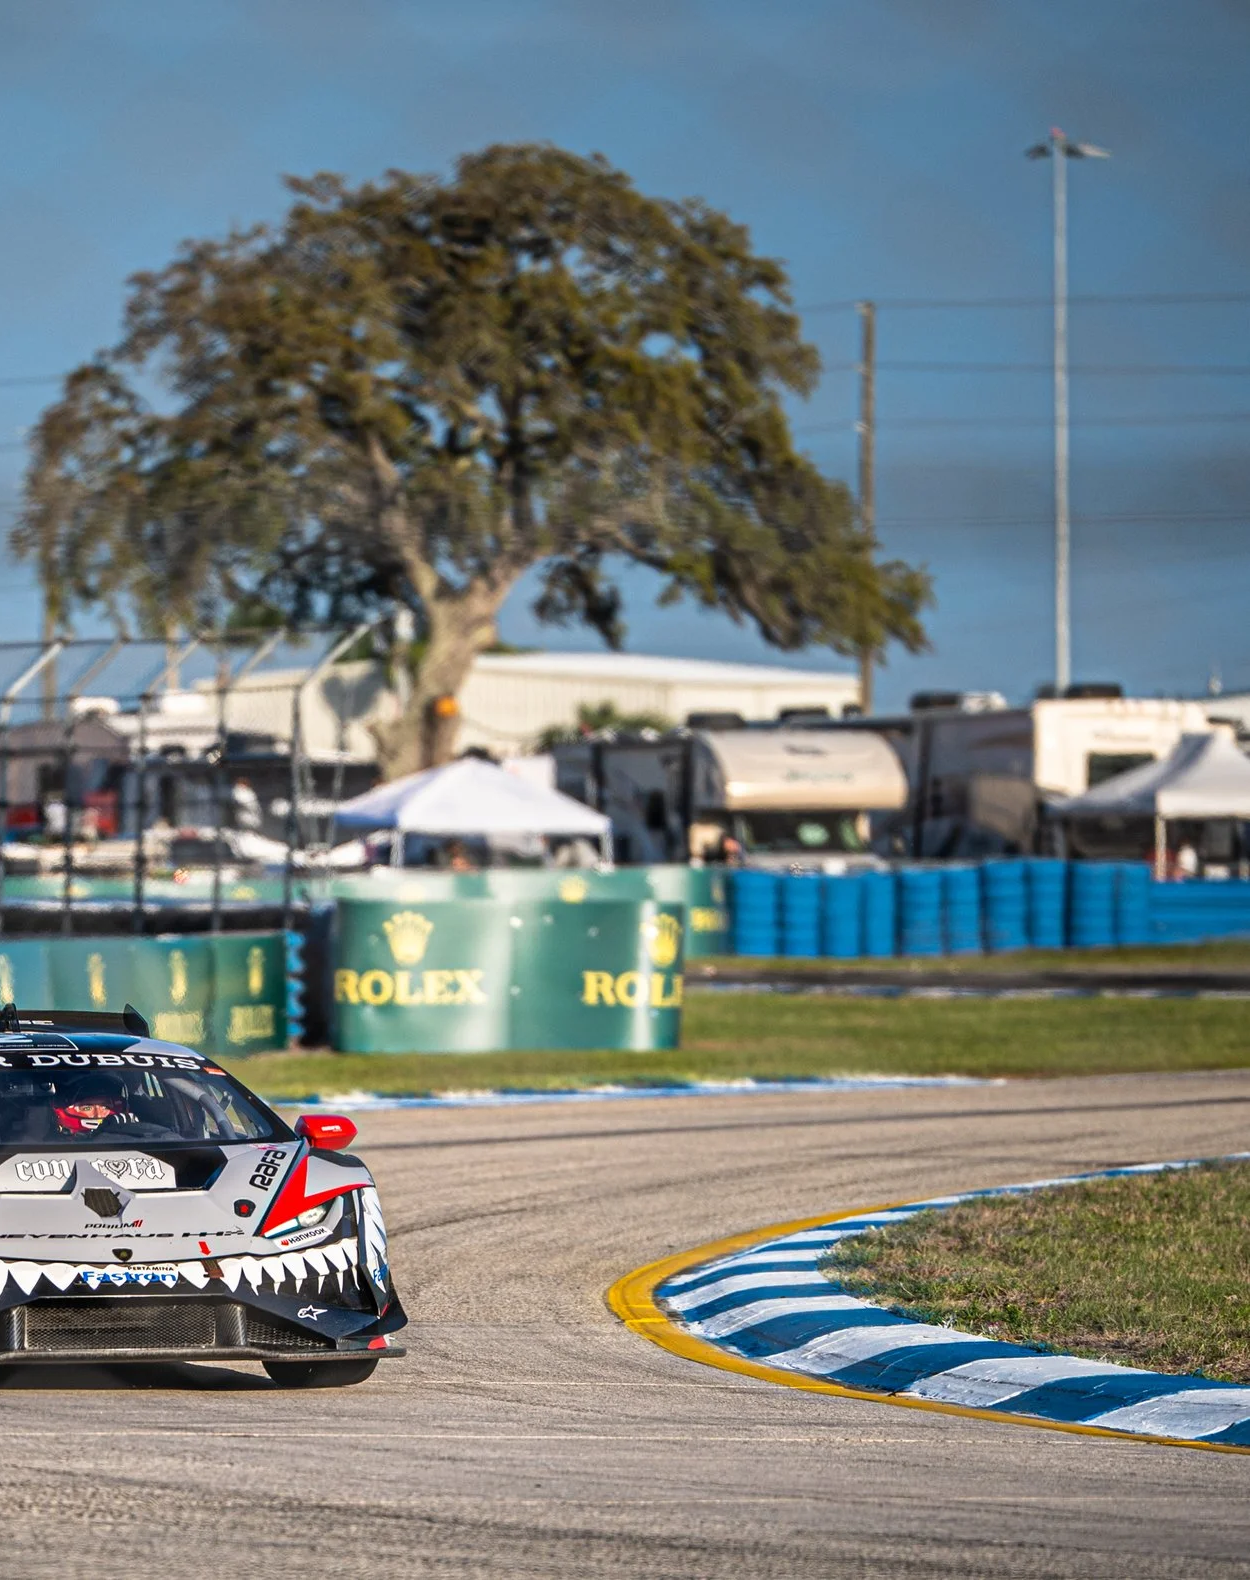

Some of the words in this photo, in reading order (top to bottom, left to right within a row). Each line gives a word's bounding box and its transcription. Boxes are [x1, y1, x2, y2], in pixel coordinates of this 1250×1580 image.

[334, 968, 486, 1006] ROLEX
[27, 1053, 201, 1070] DUBUIS
[81, 1270, 178, 1284] Fastron
